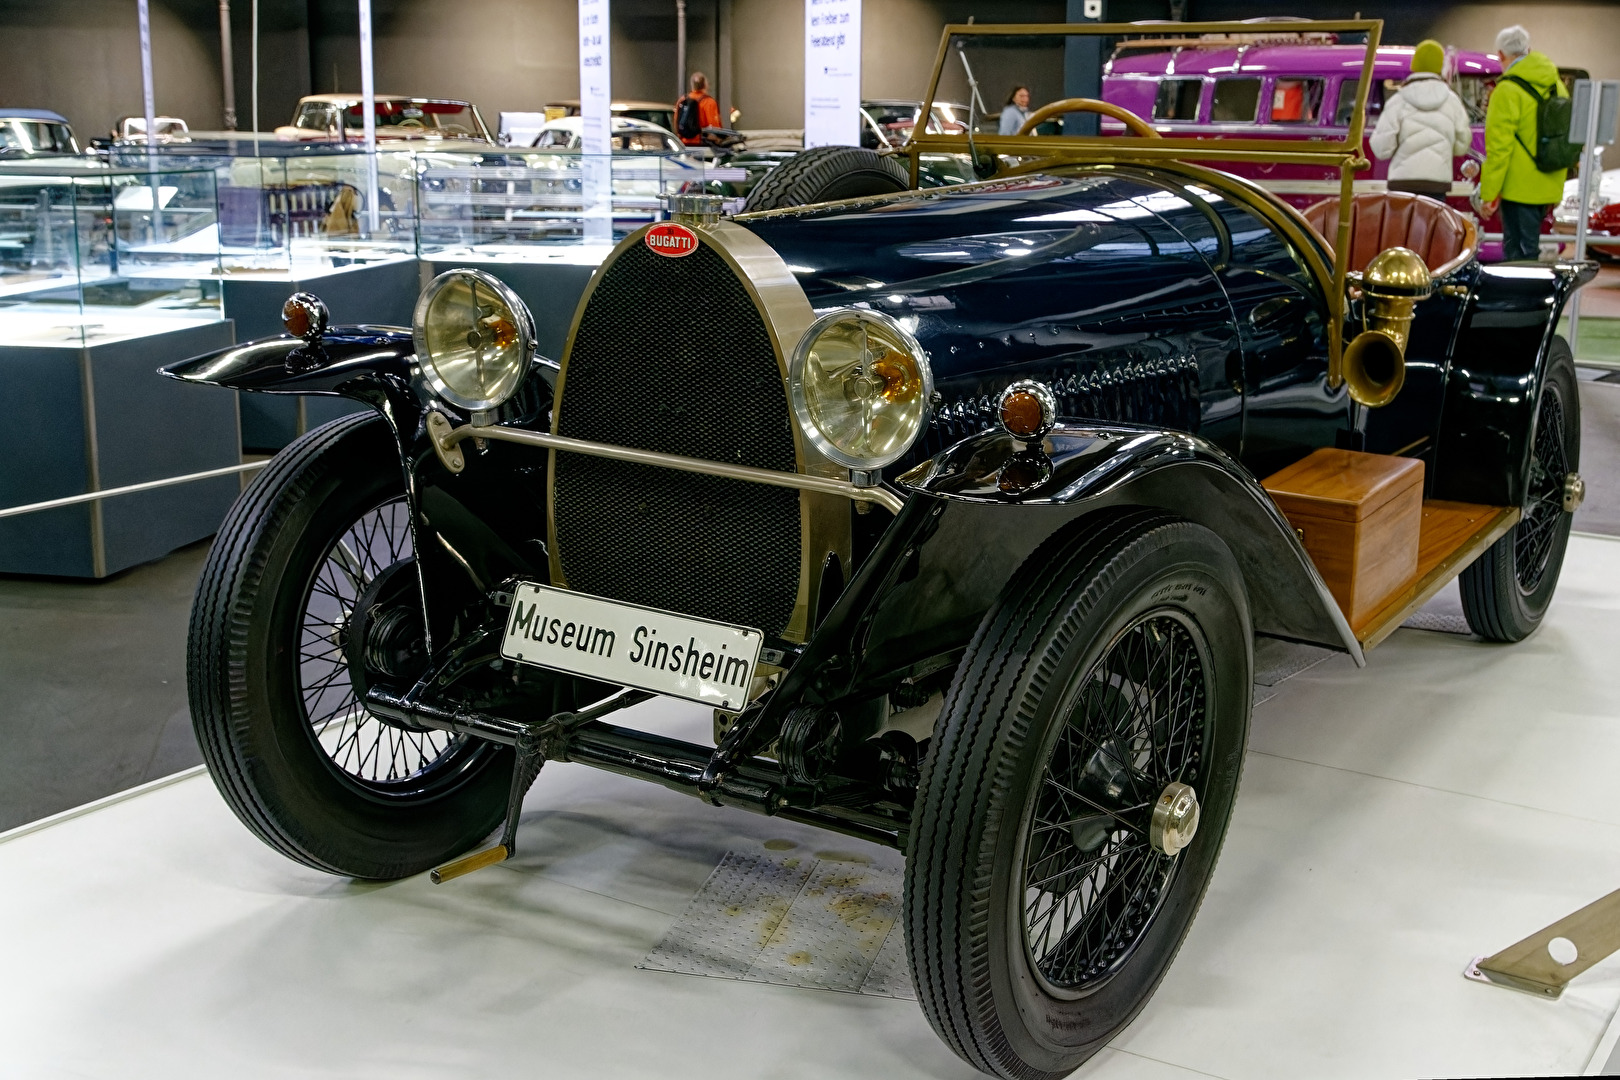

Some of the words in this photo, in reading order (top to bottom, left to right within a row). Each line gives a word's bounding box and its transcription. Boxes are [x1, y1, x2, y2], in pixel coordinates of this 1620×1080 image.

[650, 234, 691, 249] BUGATTI
[510, 600, 616, 658] Museum
[629, 625, 750, 688] Sinsheim
